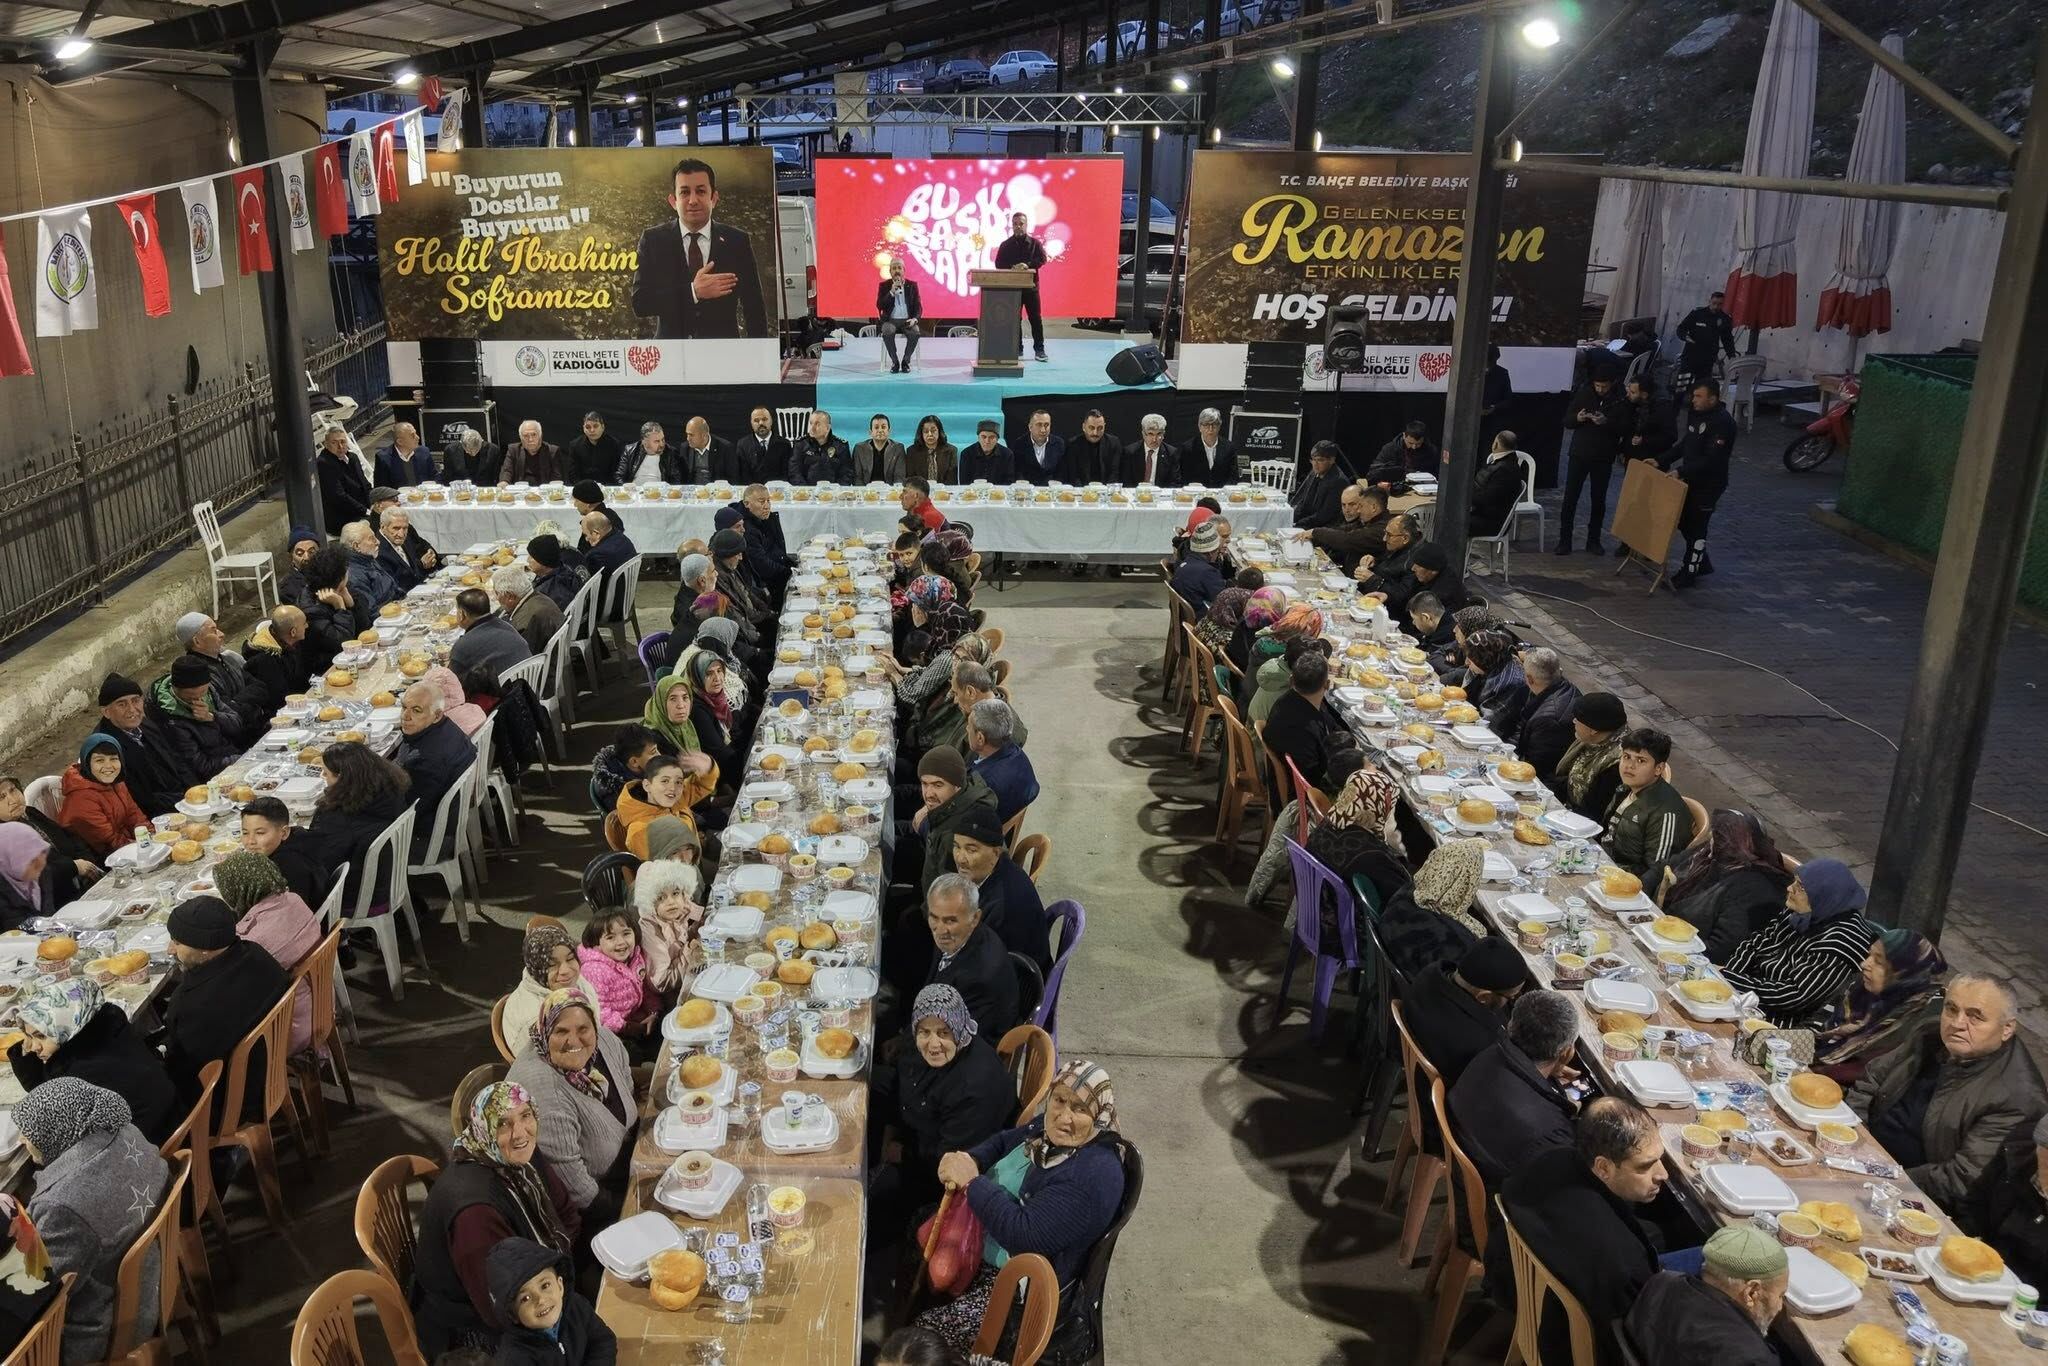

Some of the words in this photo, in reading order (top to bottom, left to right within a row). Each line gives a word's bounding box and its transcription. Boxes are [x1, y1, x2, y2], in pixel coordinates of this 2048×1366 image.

[1280, 175, 1301, 186] T.C.
[1306, 176, 1356, 190] BAHÇE
[1359, 174, 1427, 187] BELEDİYE
[468, 191, 560, 217] Dostlar
[1232, 194, 1545, 265] Ramazn
[394, 236, 494, 276] Halil
[501, 227, 640, 276] İbrahim
[1305, 261, 1461, 279] ETKİNLİKLER
[441, 274, 612, 322] Soframıza
[1252, 293, 1329, 328] HOŞ
[553, 350, 591, 359] ZEYNEL
[594, 350, 619, 359] METE
[553, 357, 620, 370] KADIOĞLU
[1384, 355, 1410, 364] METE
[1345, 363, 1410, 375] DIOĞLU
